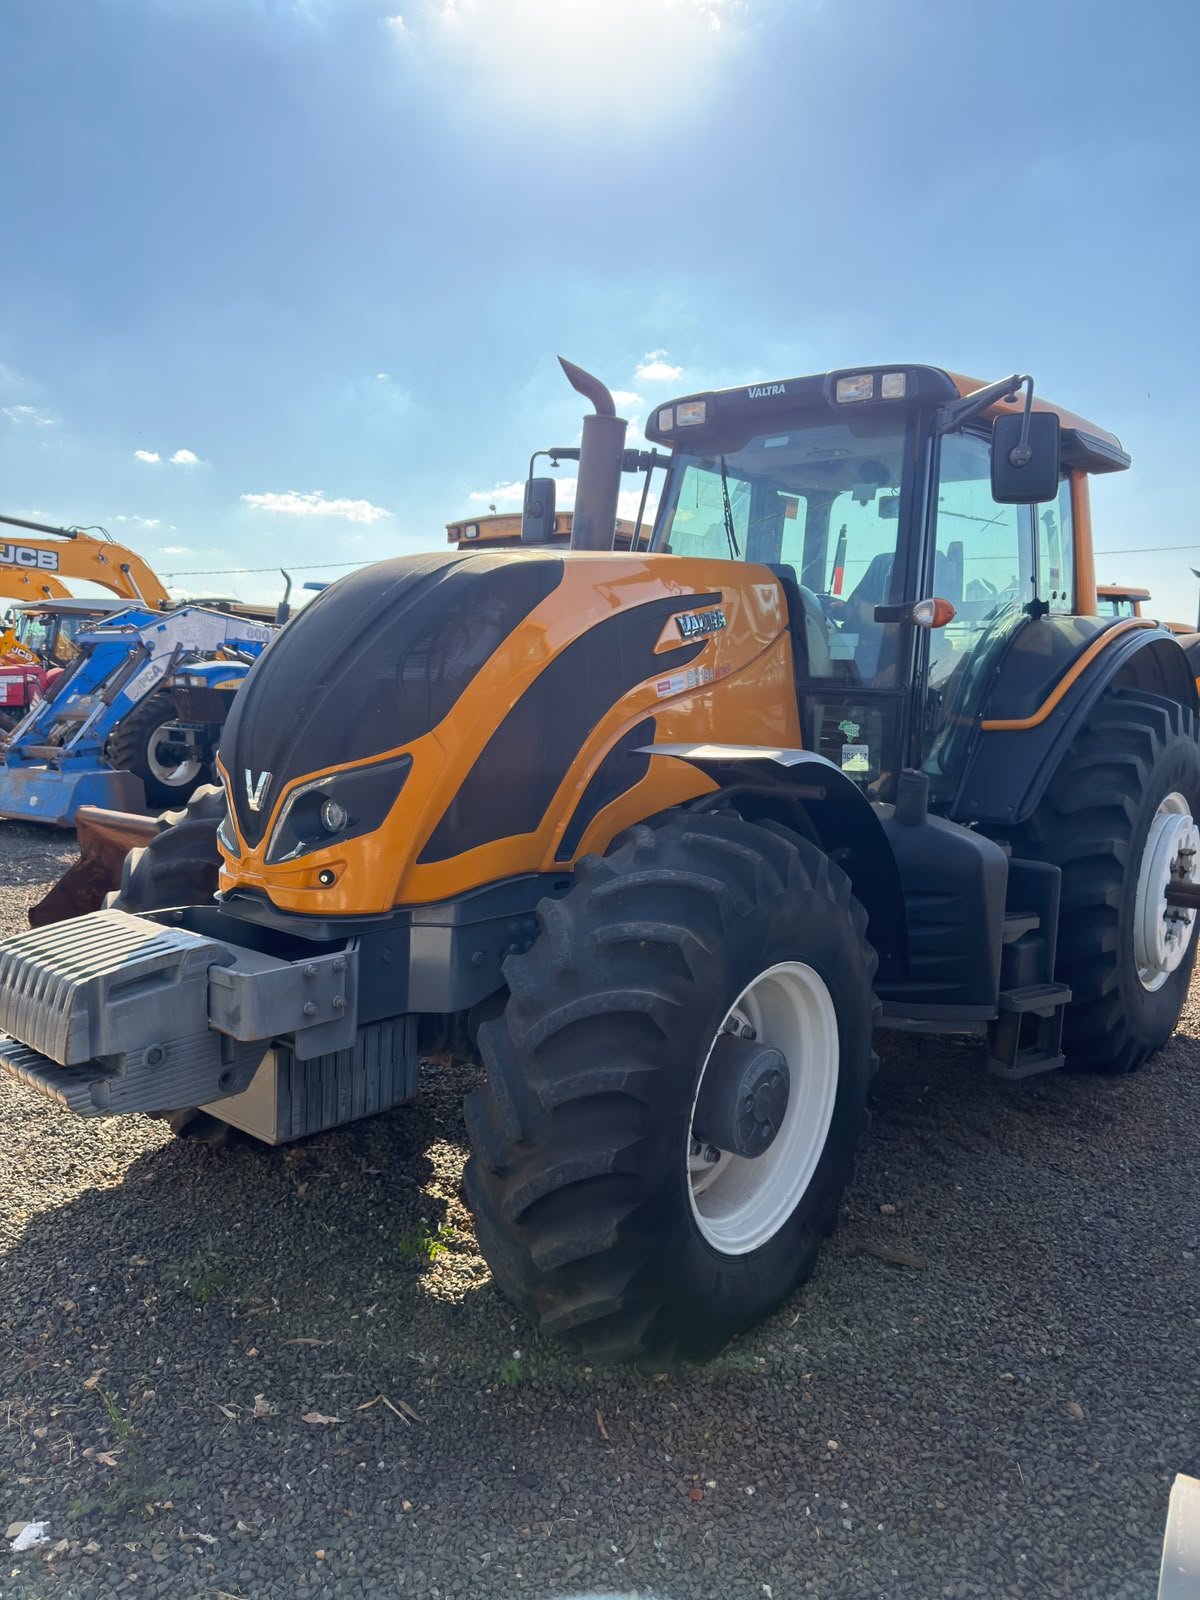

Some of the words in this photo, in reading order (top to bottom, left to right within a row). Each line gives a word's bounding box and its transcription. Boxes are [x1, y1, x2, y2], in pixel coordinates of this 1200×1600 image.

[748, 384, 785, 399] VALTRA
[0, 545, 58, 570] JCB
[11, 646, 33, 661] JCB
